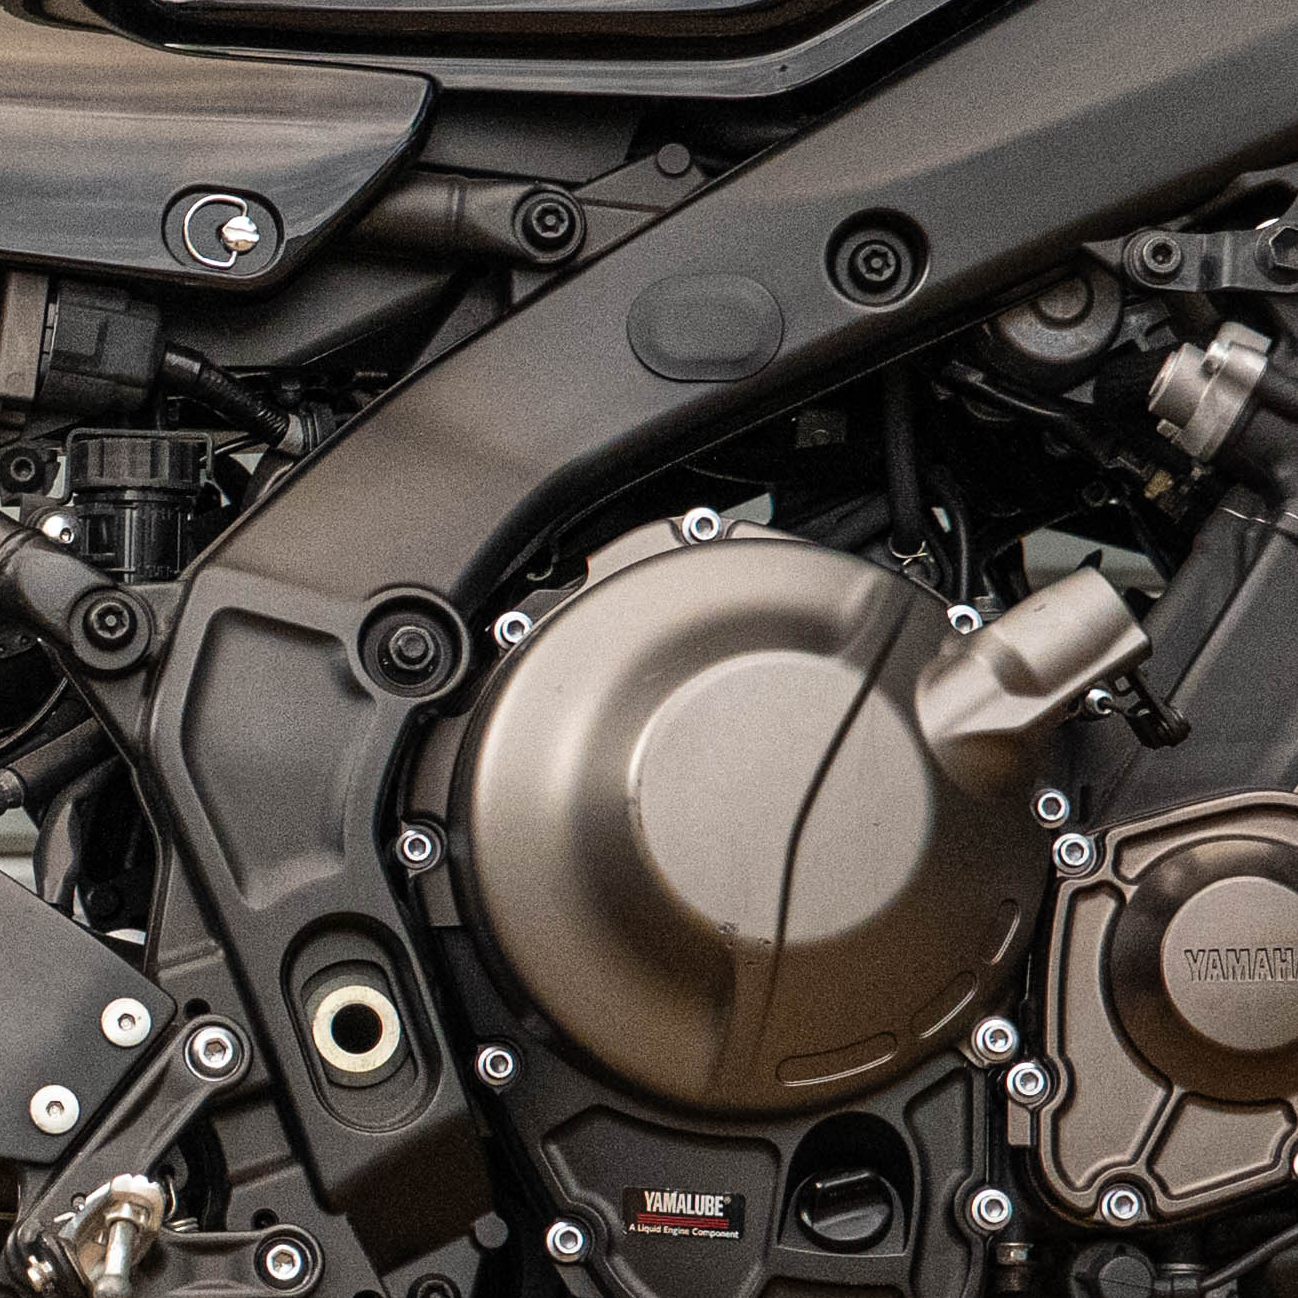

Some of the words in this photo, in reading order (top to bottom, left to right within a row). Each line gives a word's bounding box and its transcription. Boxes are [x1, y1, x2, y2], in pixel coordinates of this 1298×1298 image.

[1184, 948, 1298, 982] YAMAH
[629, 1223, 636, 1232] A
[637, 1225, 662, 1234] Liquid
[663, 1226, 690, 1237] Engine
[692, 1227, 739, 1239] Component
